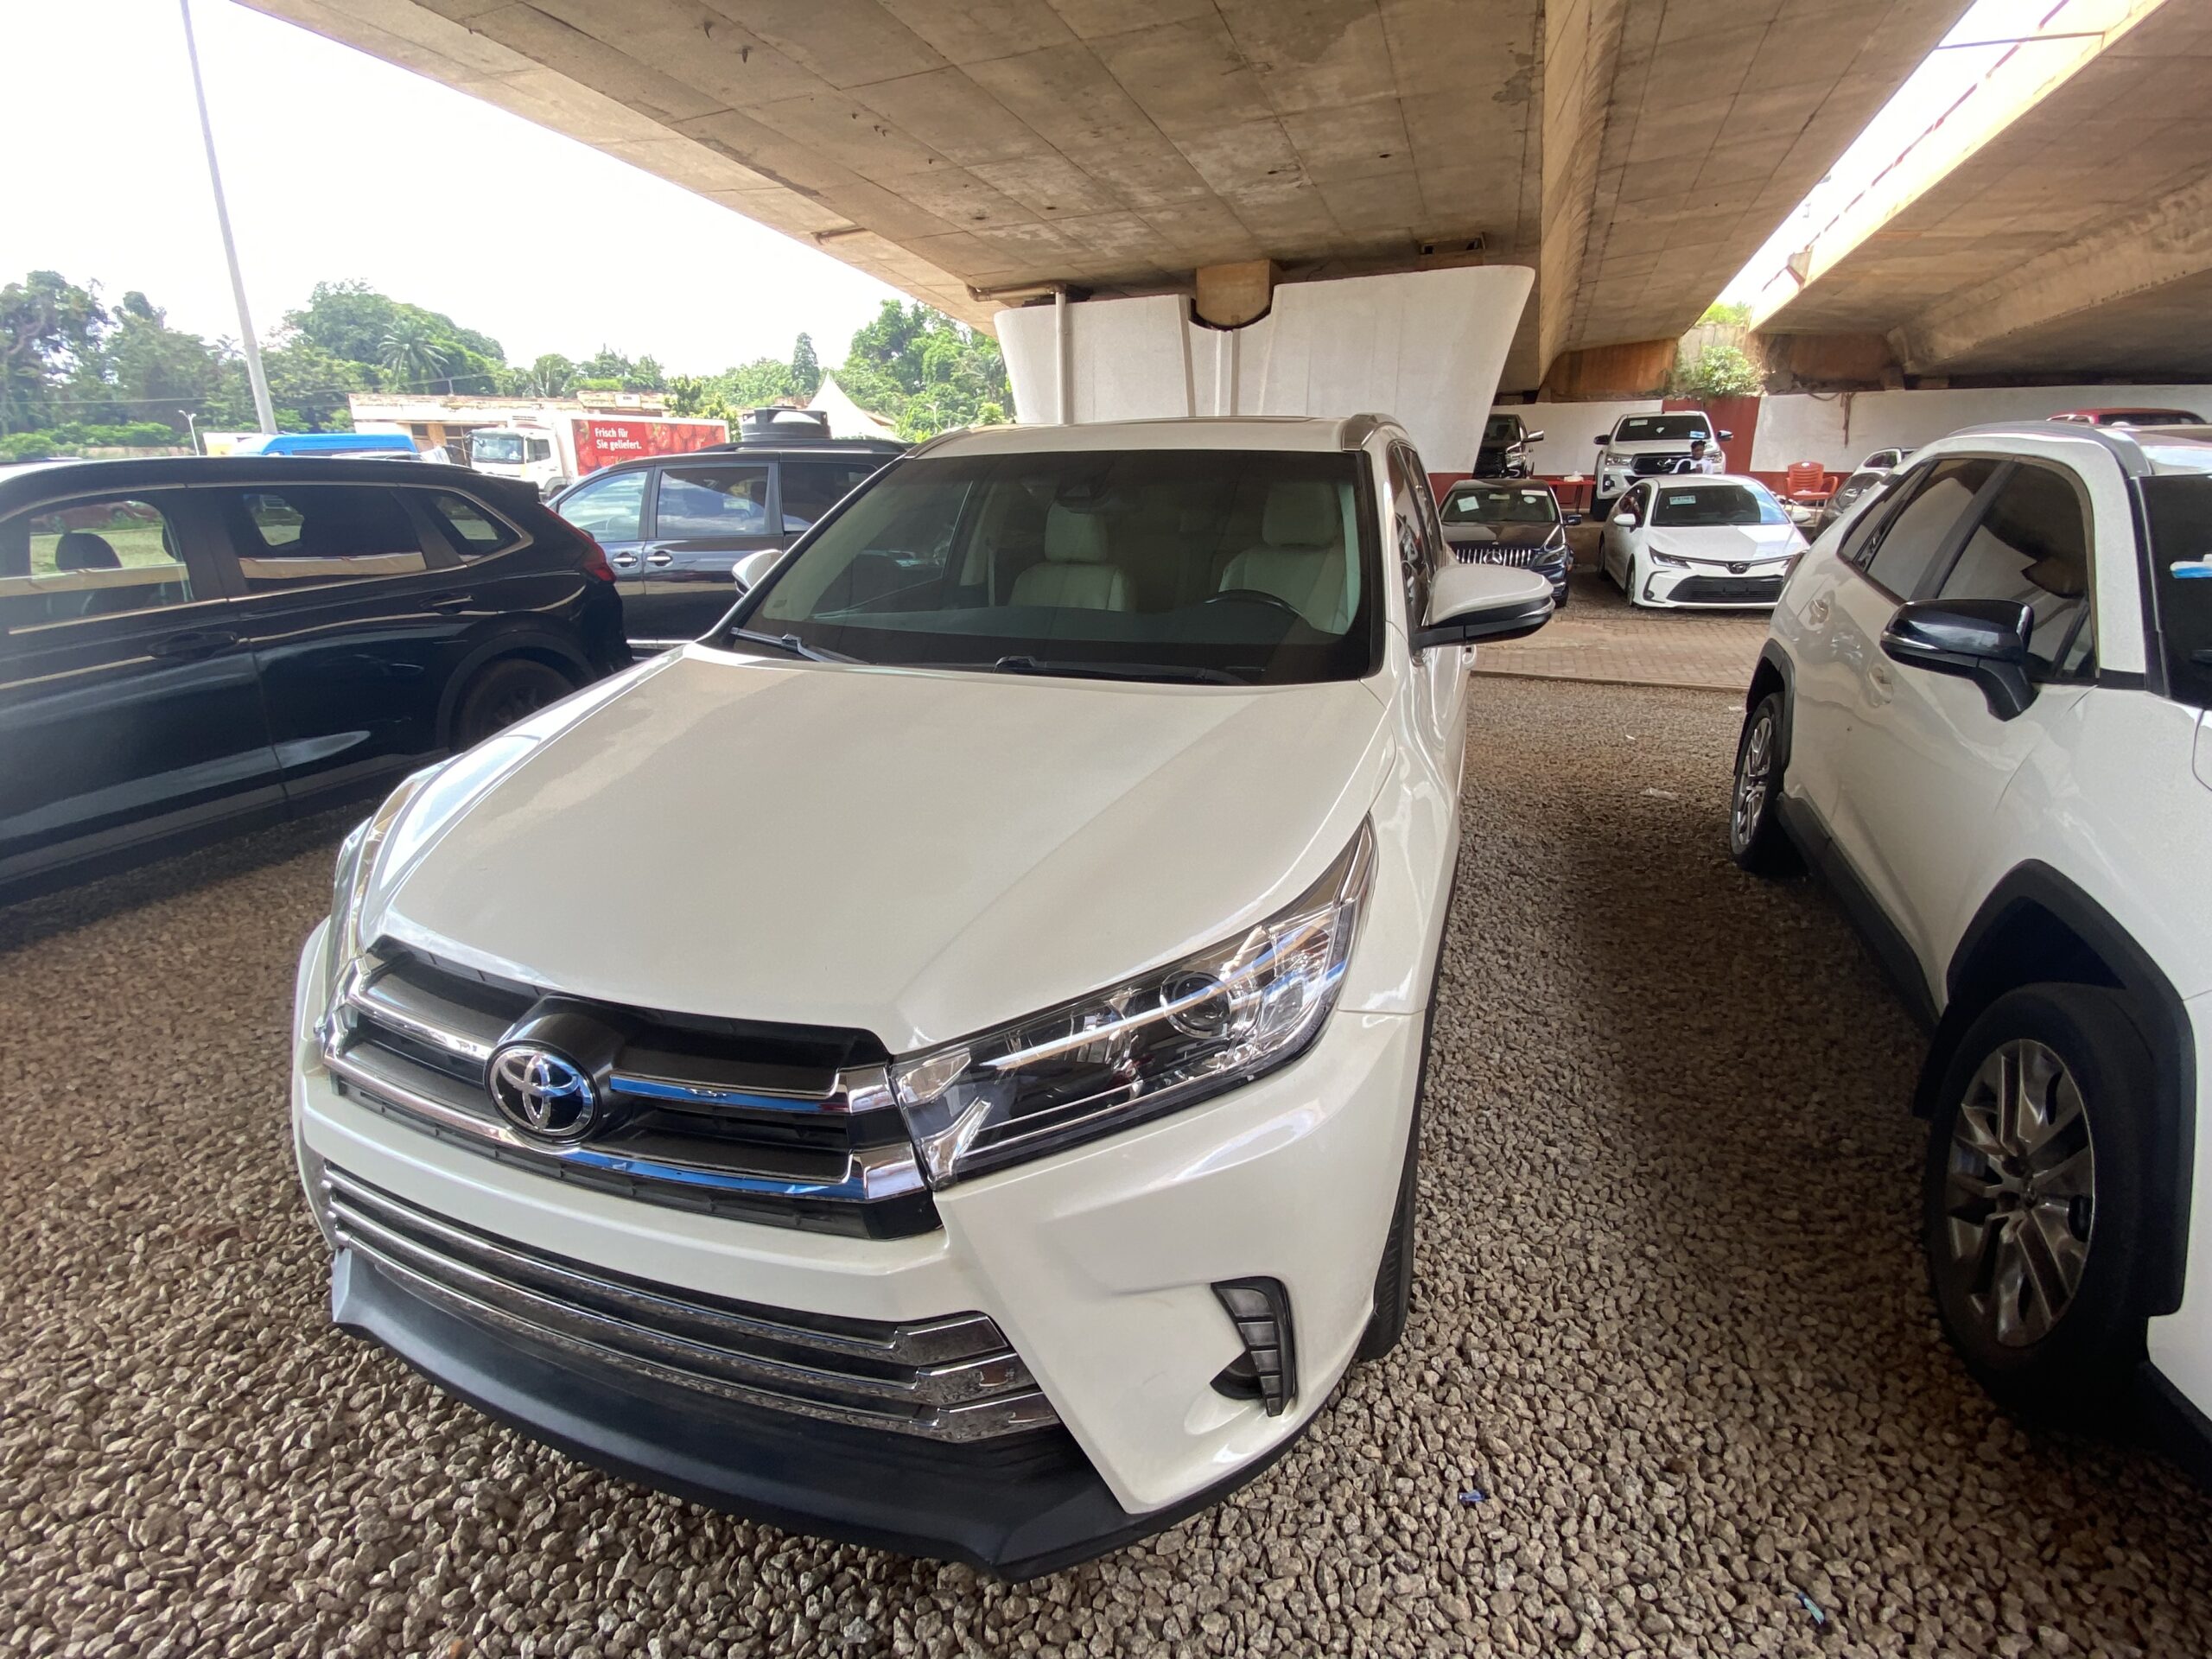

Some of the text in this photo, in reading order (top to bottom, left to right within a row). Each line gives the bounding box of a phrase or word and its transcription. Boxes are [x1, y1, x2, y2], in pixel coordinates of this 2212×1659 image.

[594, 427, 629, 438] Frisch für
[596, 439, 642, 451] Sie geliefert.
